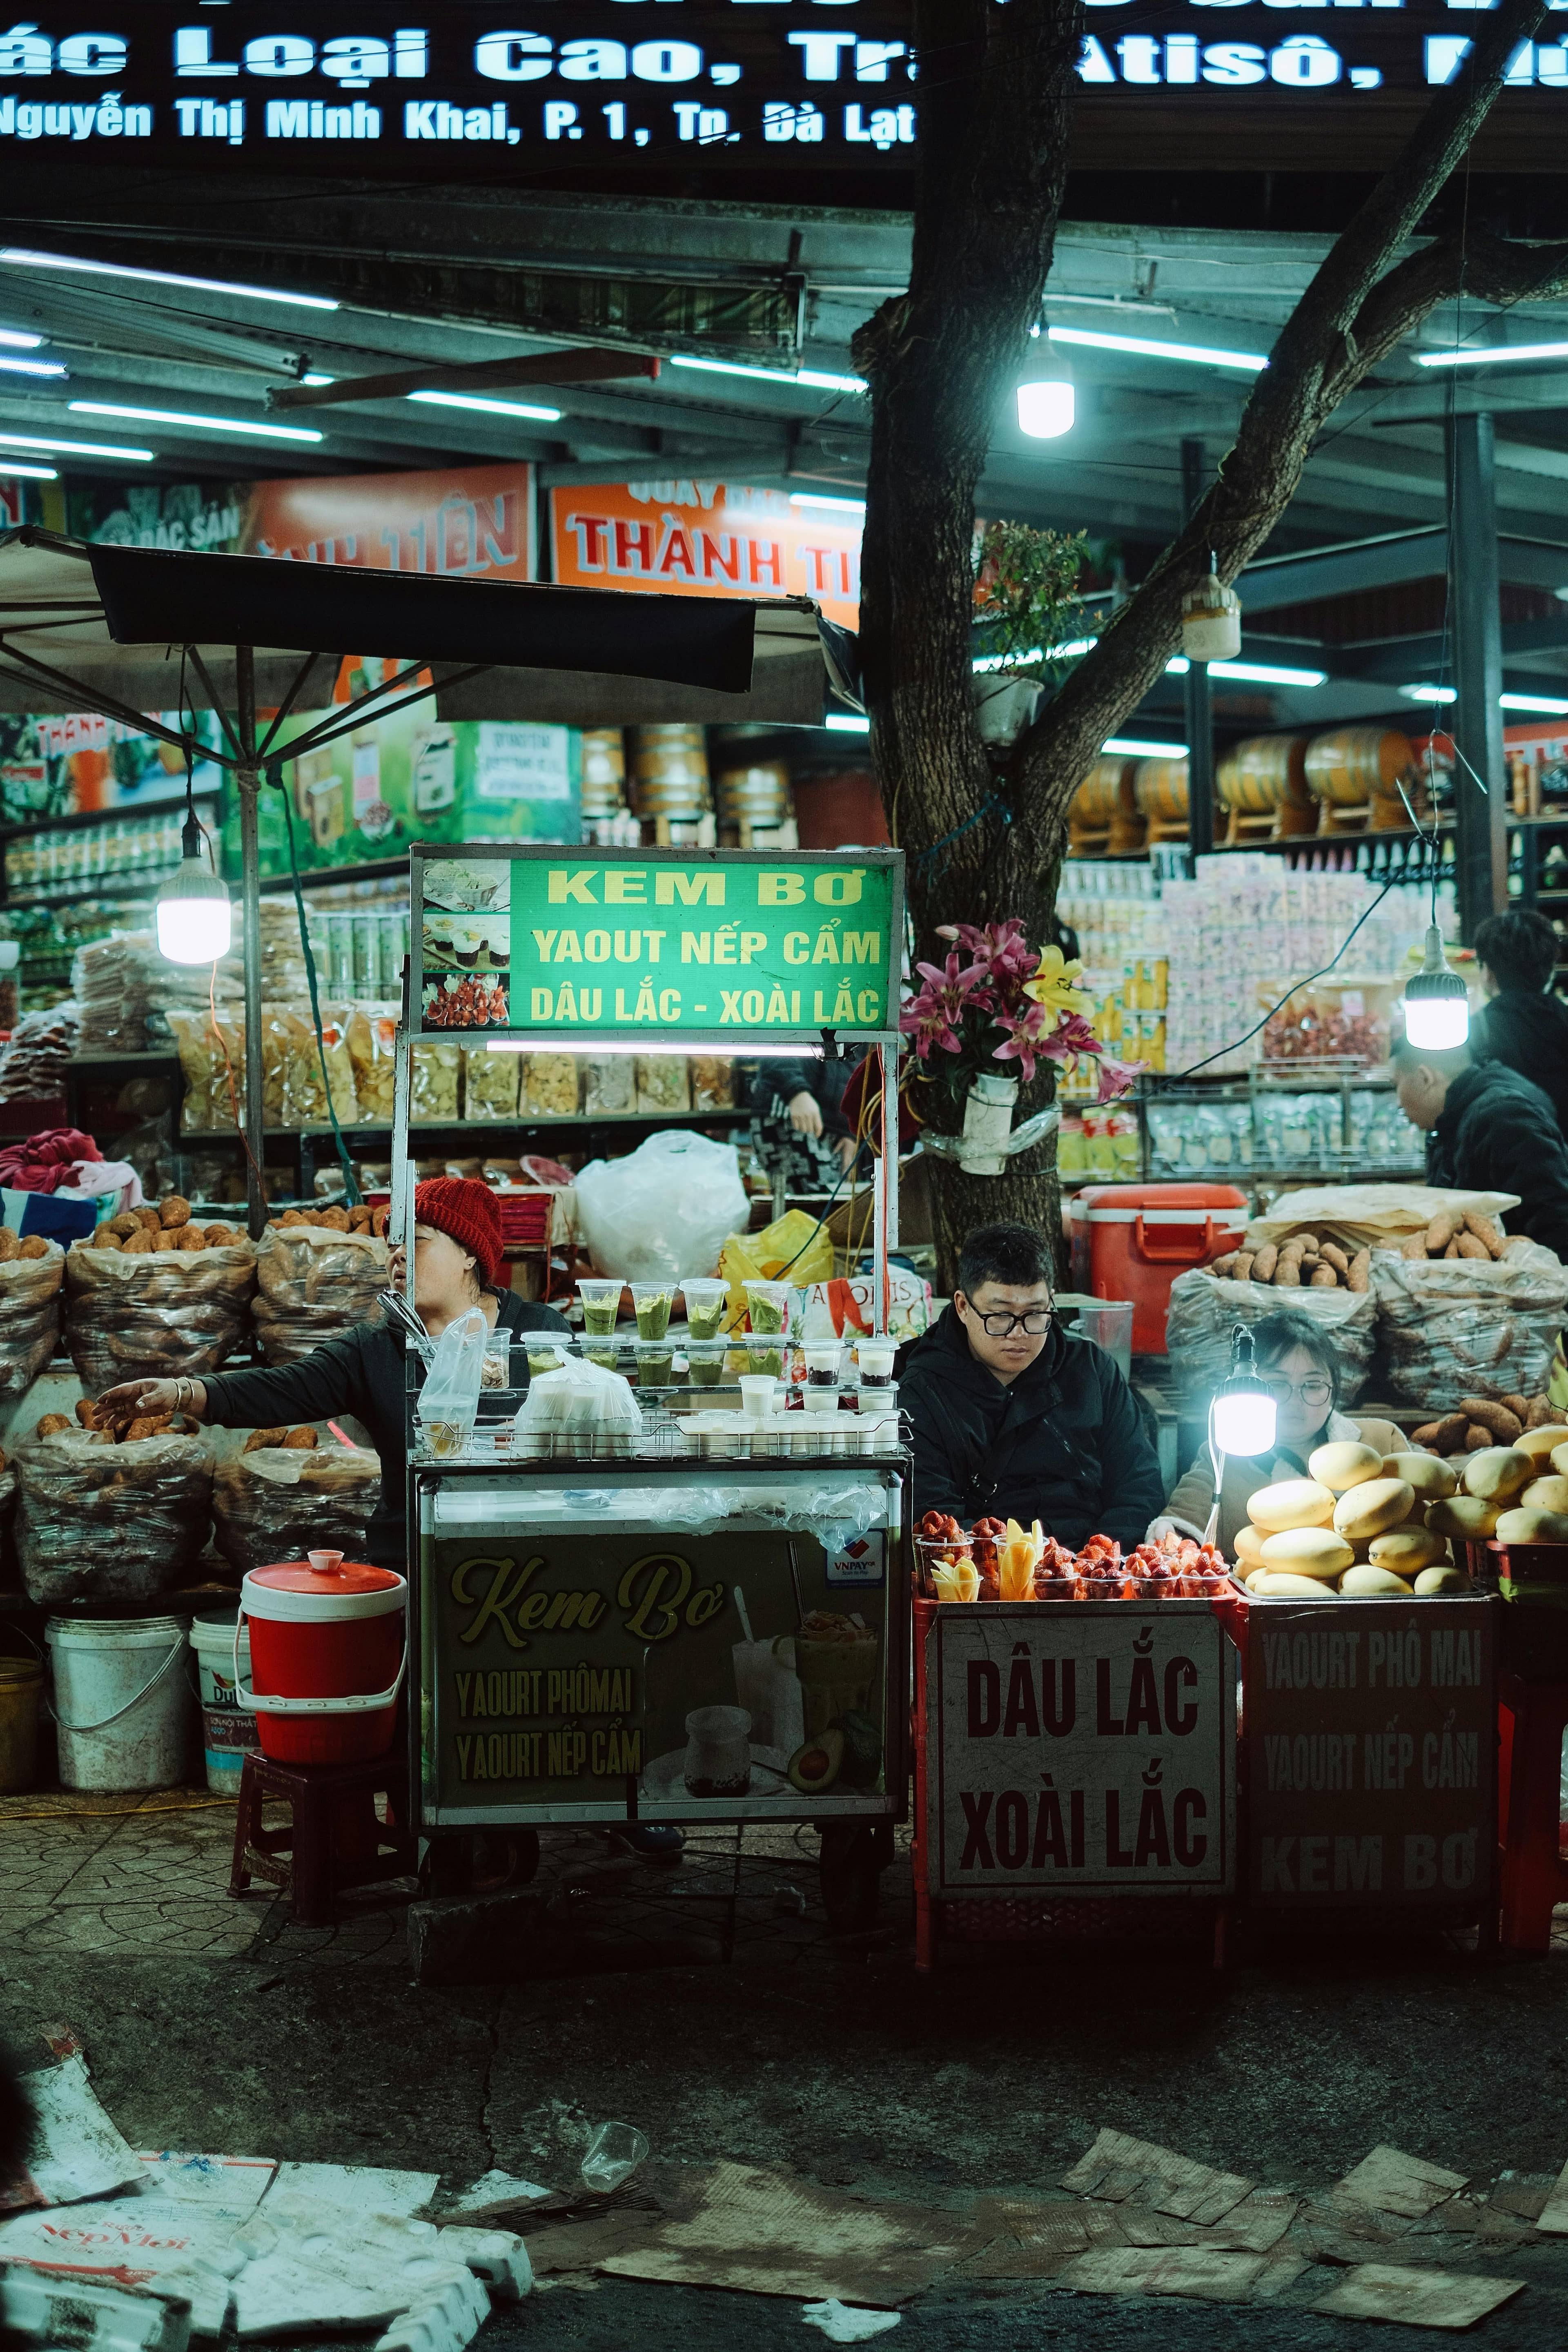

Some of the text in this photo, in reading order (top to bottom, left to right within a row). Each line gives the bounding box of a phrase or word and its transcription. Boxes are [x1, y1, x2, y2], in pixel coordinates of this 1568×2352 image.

[176, 29, 425, 88] Loại
[476, 32, 740, 85] Cao,
[788, 33, 916, 81] Tr
[176, 100, 243, 145] Thị
[267, 101, 380, 138] Minh
[405, 102, 520, 145] Khai,
[545, 102, 582, 139] P.
[603, 102, 649, 146] 1,
[845, 104, 915, 150] Lạt
[568, 513, 784, 591] THÀNH
[548, 869, 866, 906] KEM BƠ
[532, 918, 880, 965] YAOUT NẾP CẨM
[531, 981, 602, 1022] DÂU
[615, 975, 682, 1022] LẮC
[719, 982, 801, 1024] XOÀI
[814, 977, 880, 1022] LẮC
[451, 1554, 724, 1648] Kem Bơ
[967, 1626, 1198, 1738] DÂU LẮC
[1263, 1618, 1481, 1690] YAOURT PHÔ MAI
[455, 1662, 631, 1717] YAOURT PHÔMAI
[455, 1717, 641, 1780] YAOURT NẾP CẨM
[1264, 1734, 1357, 1791] YAOURT
[1364, 1714, 1414, 1790] NẾP
[959, 1758, 1207, 1870] XOÀI LẮC
[1260, 1826, 1479, 1893] KEM BƠ
